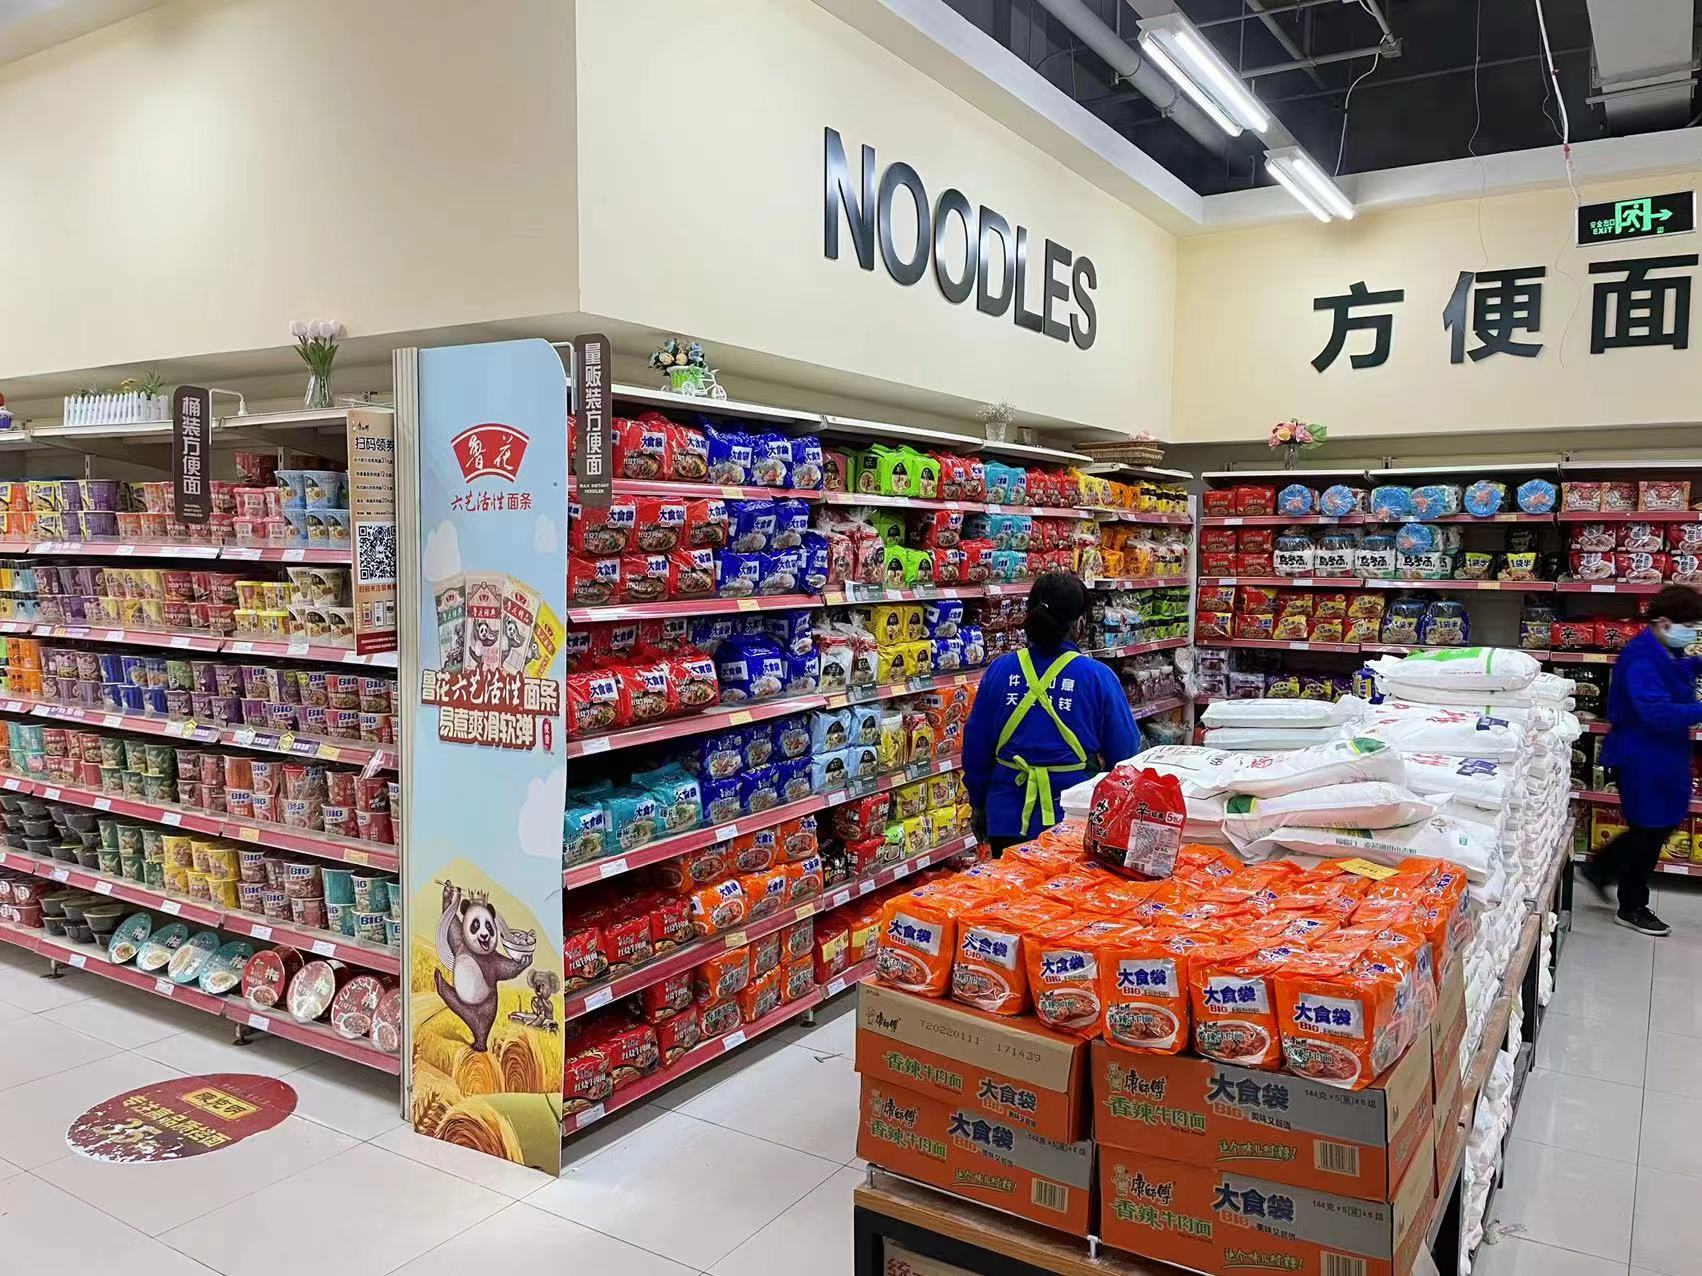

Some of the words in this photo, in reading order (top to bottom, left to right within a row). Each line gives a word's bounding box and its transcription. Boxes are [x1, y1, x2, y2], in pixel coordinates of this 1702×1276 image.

[824, 126, 1097, 350] NOODLES
[1593, 227, 1613, 235] EXIT
[1311, 254, 1699, 373] 方便面
[585, 343, 602, 476] 量贩装方便面
[182, 396, 200, 495] 桶装方便面
[466, 433, 514, 471] 鲁花
[450, 491, 533, 512] 六艺活性面条
[366, 680, 387, 689] BIG
[422, 669, 558, 712] 鲁花六艺活性面条
[273, 705, 293, 713] BIG
[440, 706, 534, 746] 易煮爽滑软弹
[231, 792, 250, 801] BIG
[325, 810, 343, 818] BIG
[243, 854, 262, 863] BIG
[290, 867, 310, 875] BIG
[266, 893, 285, 902] BIG
[360, 916, 384, 926] BIG
[888, 919, 933, 945] 大食袋
[962, 932, 1008, 958] 大食袋
[1040, 952, 1086, 976] 大食袋
[1045, 975, 1062, 983] BIG
[1117, 967, 1167, 988] 大食袋
[1123, 987, 1141, 996] BIG
[1203, 985, 1257, 1006] 大食袋
[1209, 1004, 1229, 1013] BIG
[1294, 1002, 1352, 1027] 大食袋
[1299, 1021, 1320, 1033] BIG
[919, 1018, 980, 1046] T20220111
[997, 1043, 1042, 1063] 171439
[882, 1050, 964, 1090] 香辣牛肉面
[978, 1077, 1037, 1113] 大食袋
[1206, 1073, 1290, 1112] 大食袋
[1104, 1096, 1206, 1131] 香辣牛肉面
[1212, 1103, 1244, 1120] BIG
[866, 1117, 948, 1159] 香辣牛肉面
[948, 1112, 1014, 1152] 大食袋
[952, 1135, 978, 1154] BIG
[1212, 1183, 1295, 1223] 大食袋
[1111, 1199, 1212, 1239] 香辣牛肉面
[1218, 1210, 1250, 1228] BIG
